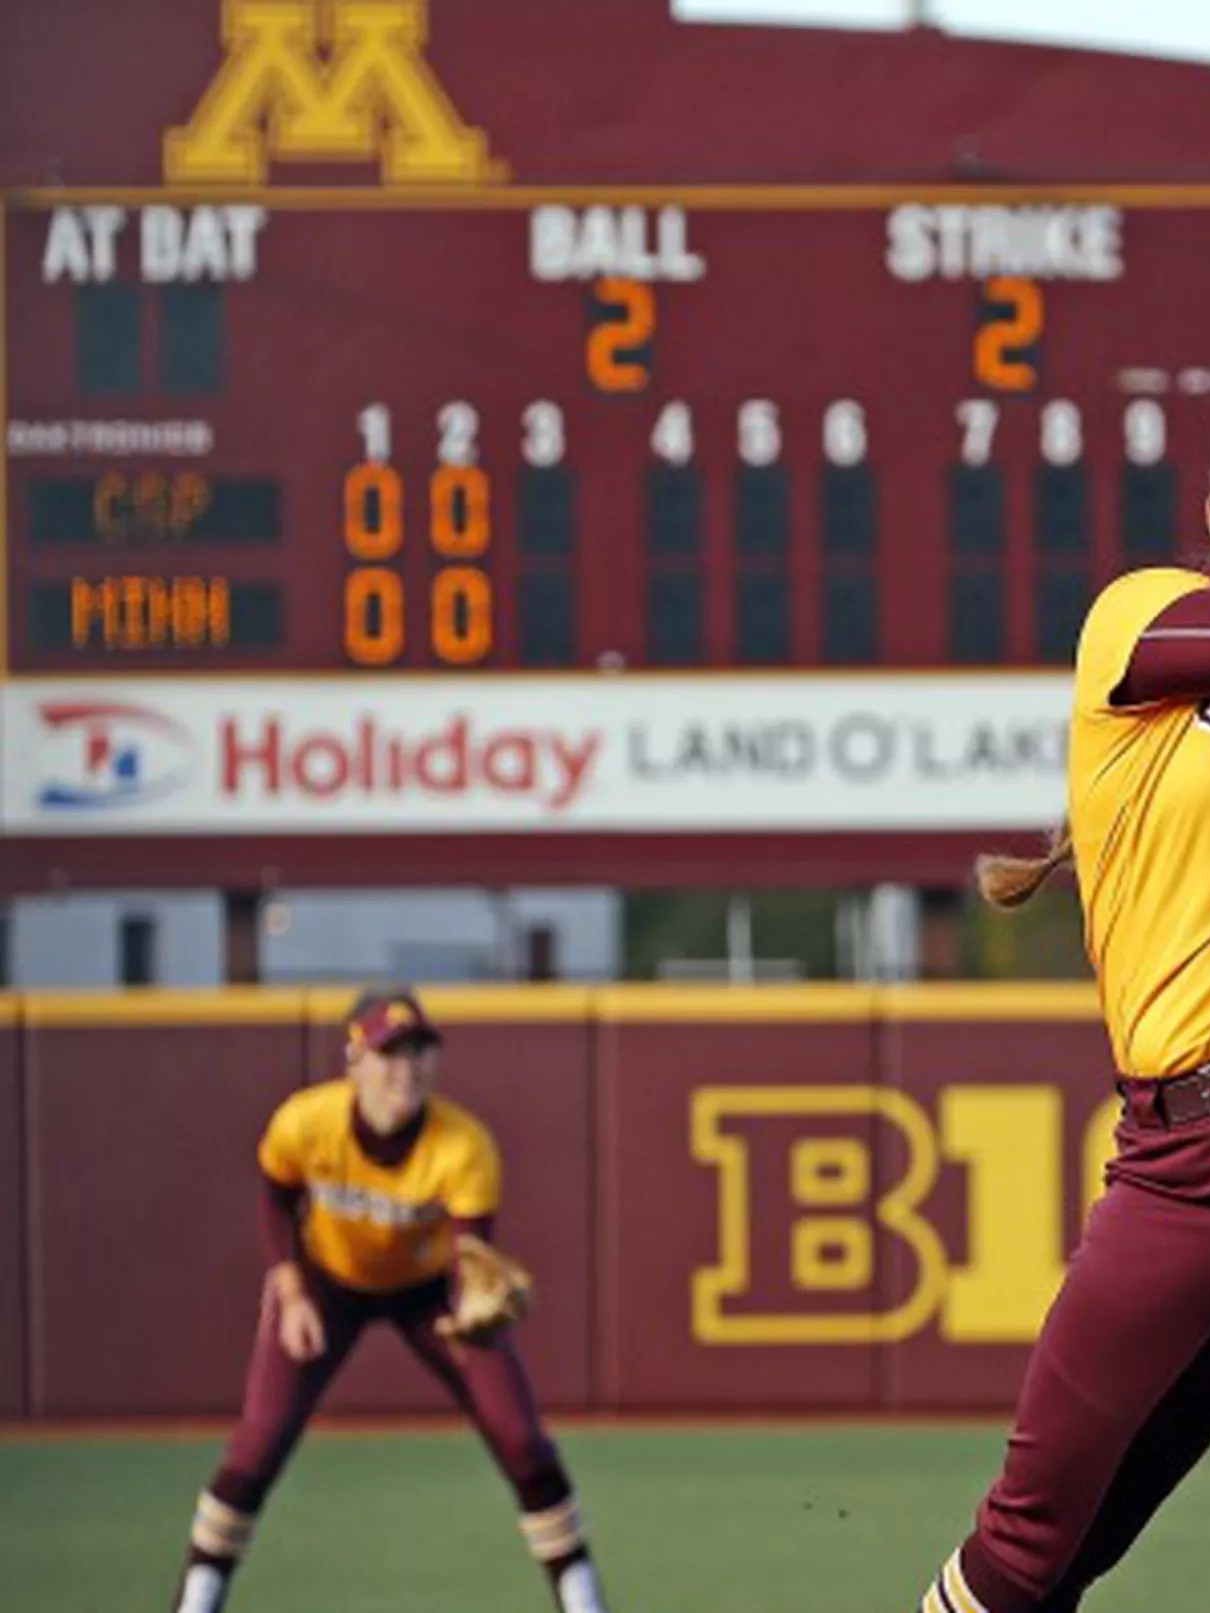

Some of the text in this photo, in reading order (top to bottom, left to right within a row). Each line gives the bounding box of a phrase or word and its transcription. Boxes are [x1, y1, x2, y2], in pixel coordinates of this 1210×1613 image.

[43, 203, 268, 283] AT BAT
[530, 205, 704, 281] BALL
[887, 203, 1123, 280] STRIKE
[587, 278, 655, 390] 2
[973, 278, 1043, 390] 2
[358, 399, 1165, 466] 1 2 3 4 5 6 7 8 9
[345, 464, 490, 559] 0 0
[71, 576, 229, 649] MINN
[345, 567, 491, 664] 0 0
[217, 714, 600, 812] Holiday
[626, 718, 816, 785] LAND
